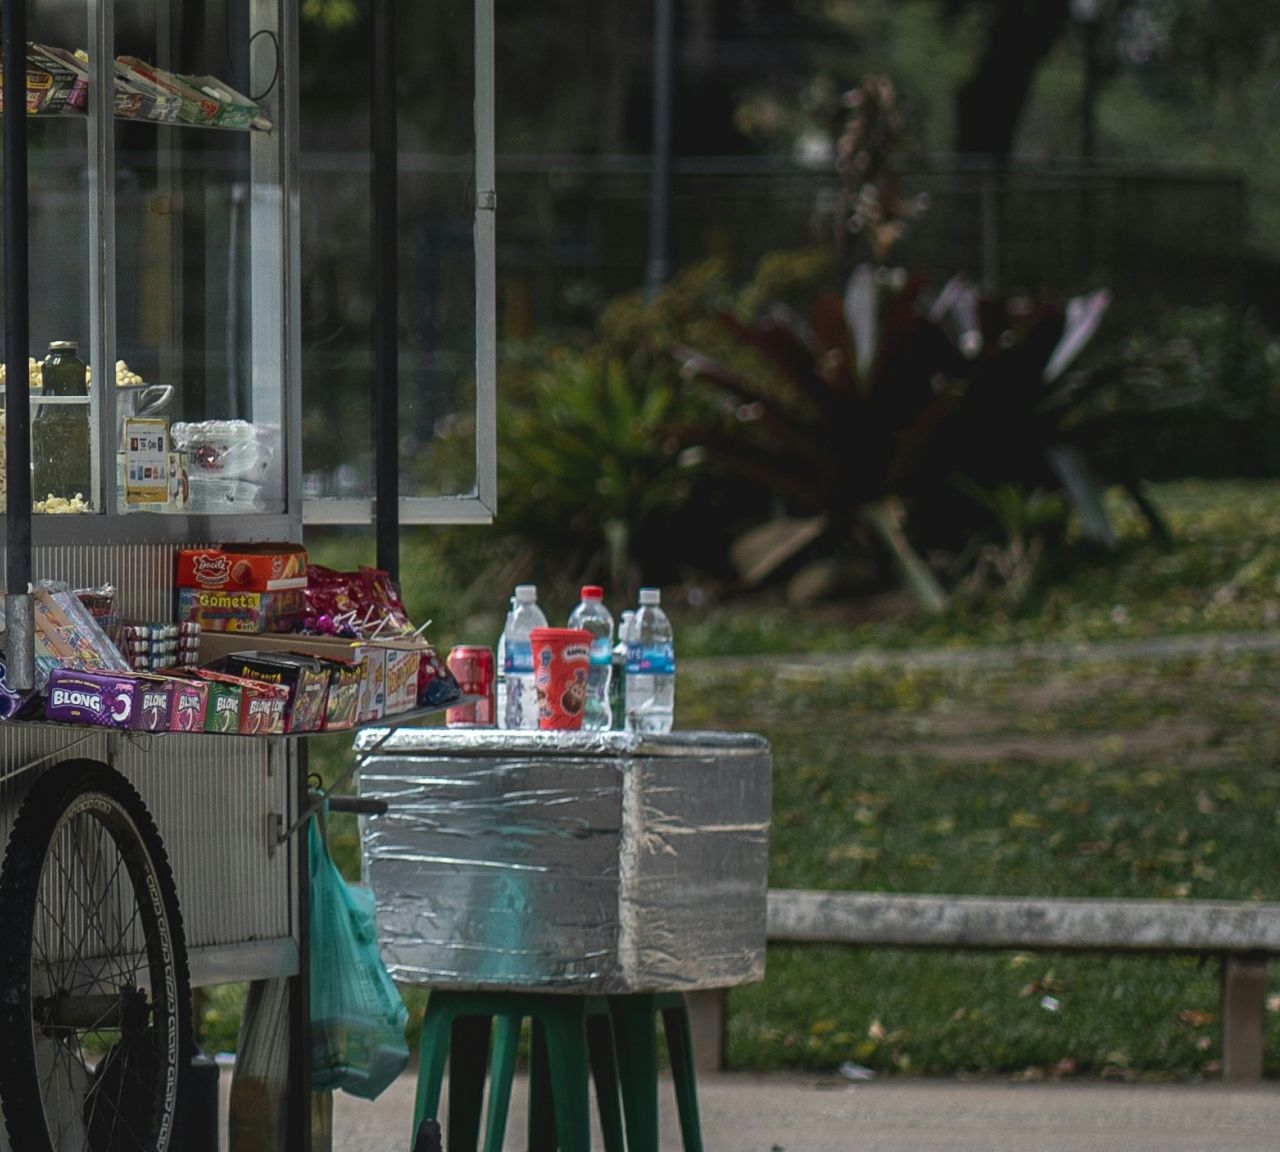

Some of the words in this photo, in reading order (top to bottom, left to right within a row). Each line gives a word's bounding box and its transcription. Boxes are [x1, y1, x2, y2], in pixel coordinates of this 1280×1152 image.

[199, 556, 227, 571] Docile
[200, 594, 257, 608] Gomets
[53, 690, 101, 713] BLONG
[143, 694, 168, 710] BLONG
